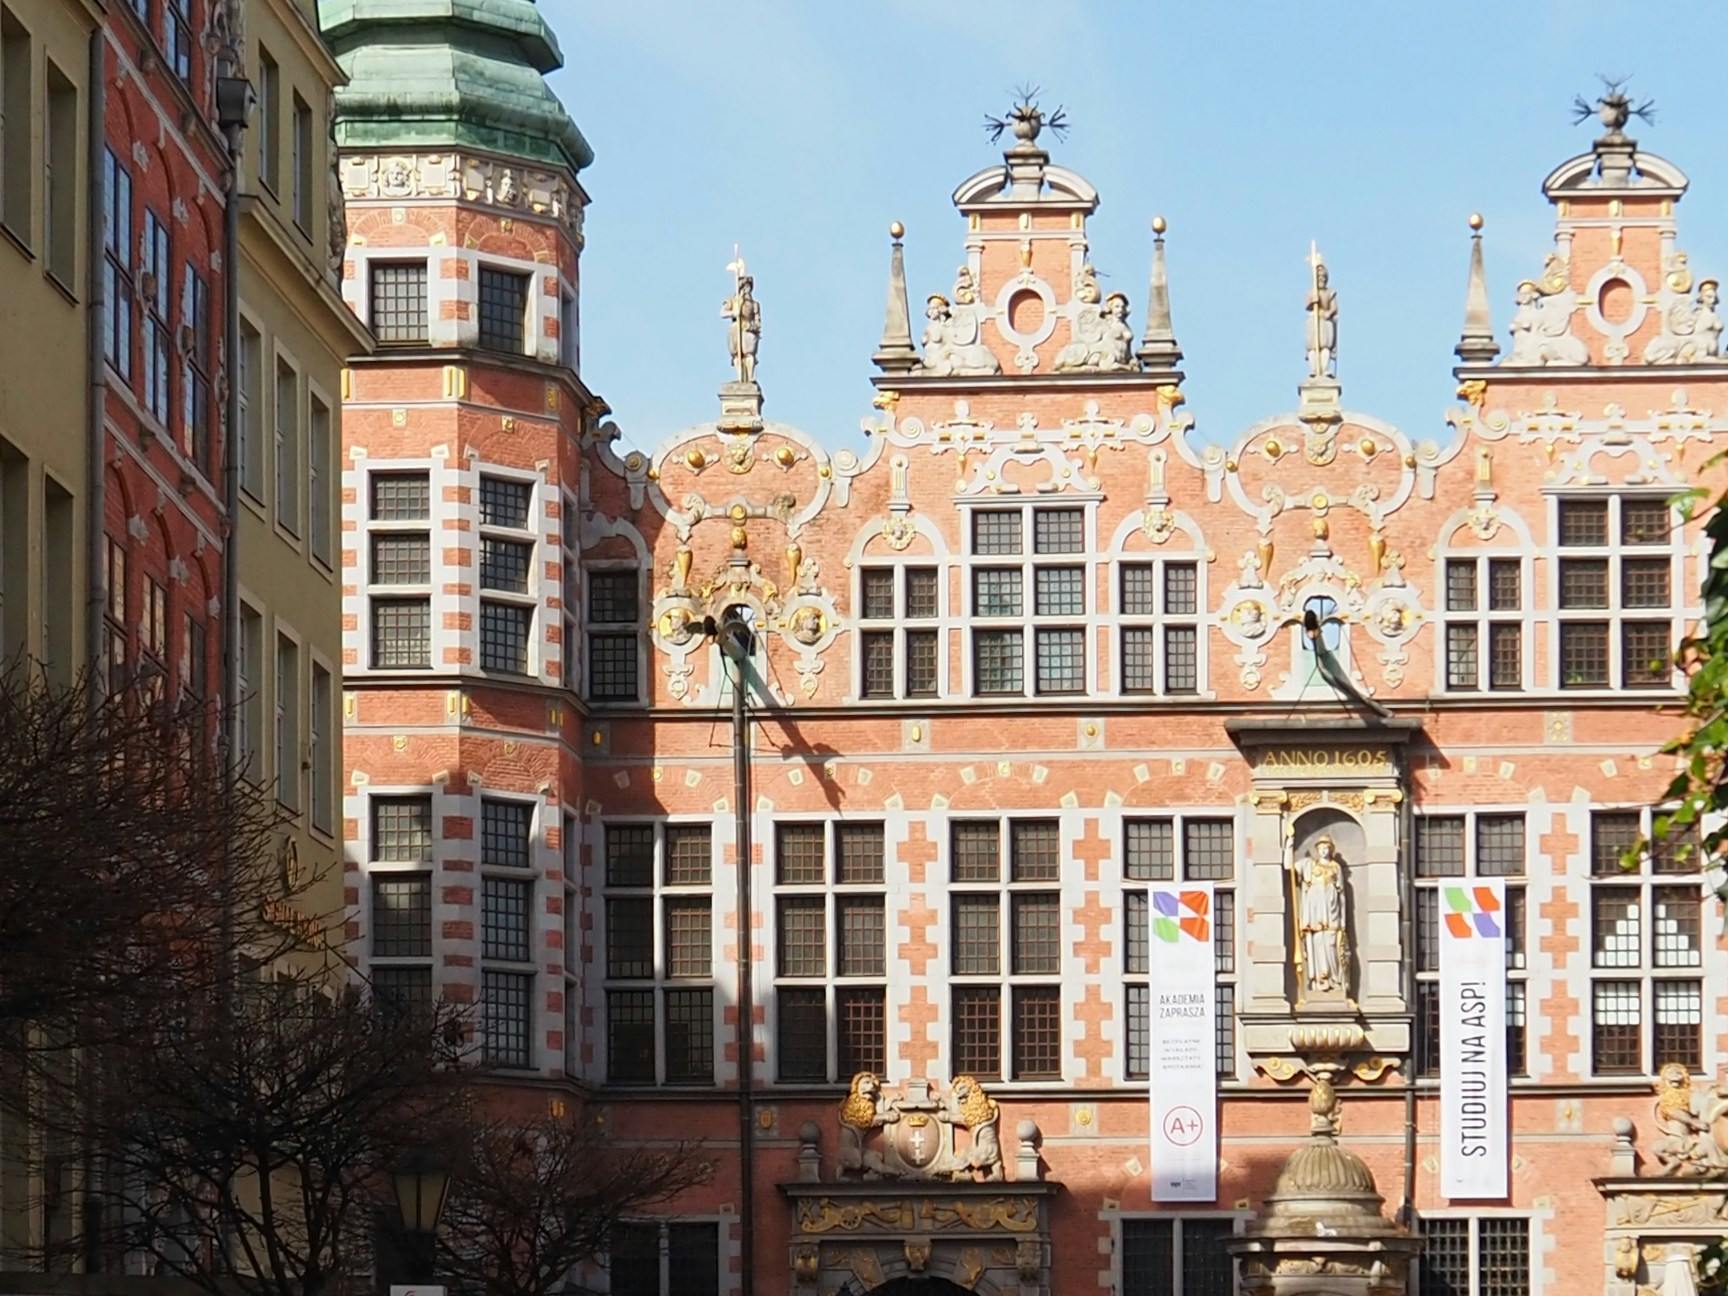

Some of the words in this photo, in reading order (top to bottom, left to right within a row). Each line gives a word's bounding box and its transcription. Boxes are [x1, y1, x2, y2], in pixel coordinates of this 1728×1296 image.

[1263, 750, 1329, 767] ANNO
[1334, 749, 1387, 767] 1605
[1159, 993, 1205, 1005] AKADEMIA
[1460, 982, 1486, 1028] ASP!
[1159, 1007, 1205, 1019] ZAPRASZA
[1461, 1035, 1487, 1063] NA
[1461, 1071, 1487, 1157] STUDIUJ
[1170, 1116, 1199, 1134] A+
